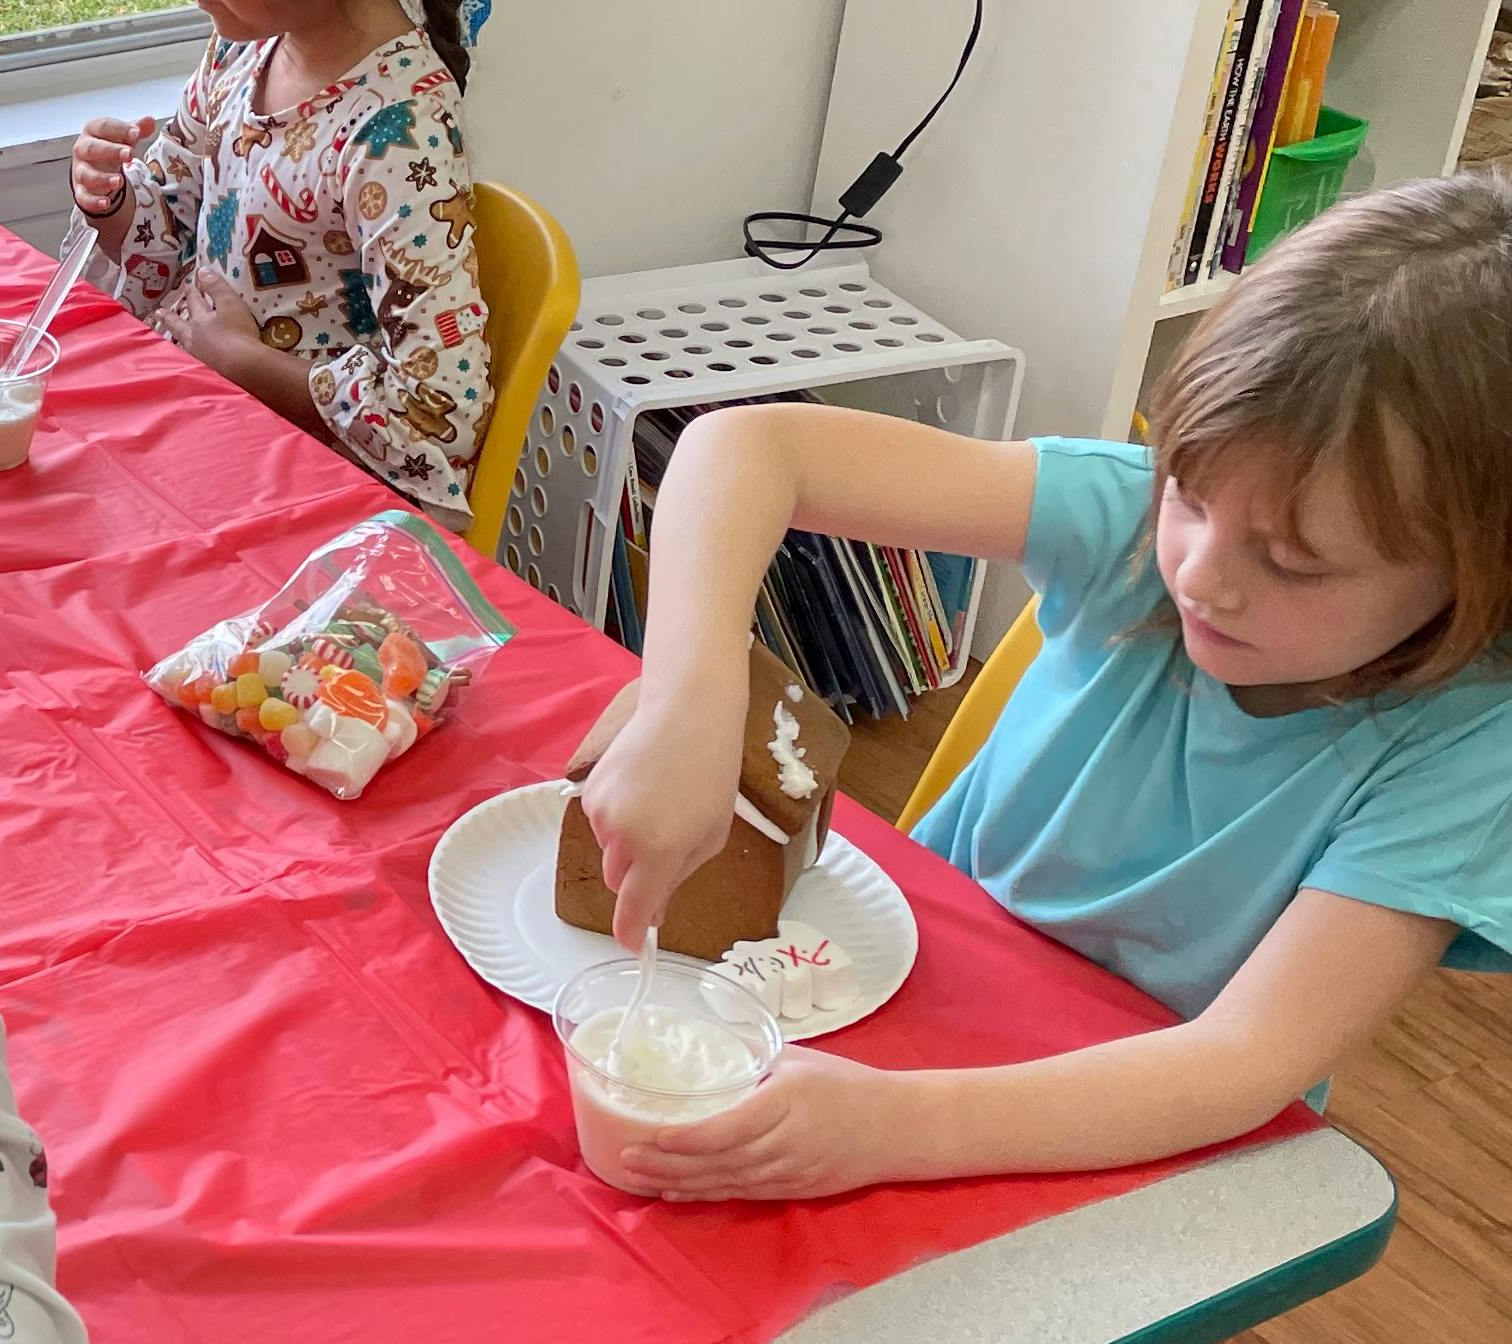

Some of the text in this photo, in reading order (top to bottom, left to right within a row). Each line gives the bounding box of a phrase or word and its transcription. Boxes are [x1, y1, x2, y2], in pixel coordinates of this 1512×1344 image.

[1231, 58, 1245, 86] HOW
[1226, 88, 1238, 108] THE
[1218, 108, 1233, 142] EARTH
[1203, 143, 1226, 205] WORKS
